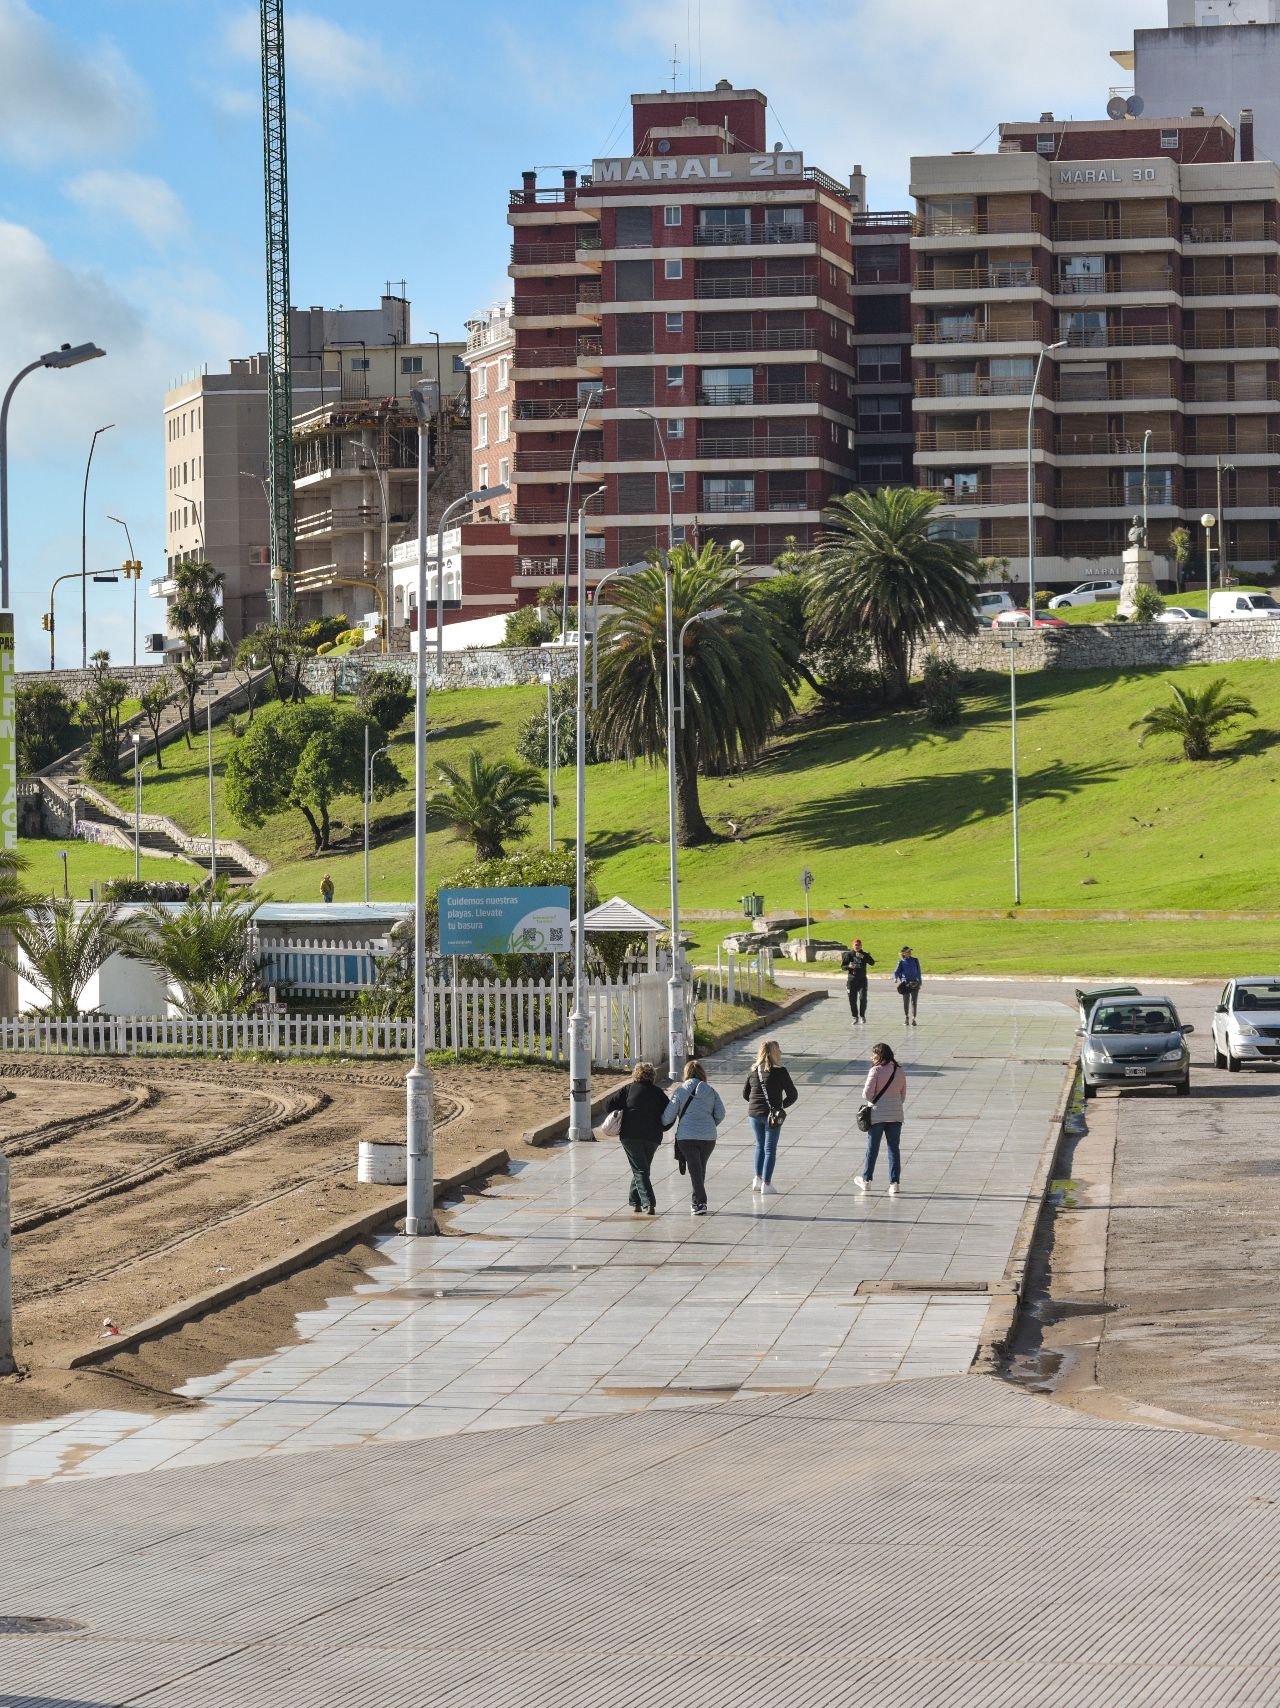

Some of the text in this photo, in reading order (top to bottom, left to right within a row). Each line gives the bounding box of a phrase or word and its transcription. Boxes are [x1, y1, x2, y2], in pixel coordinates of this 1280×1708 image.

[594, 154, 801, 182] MARAL 20
[1060, 168, 1155, 184] MARAL 30
[447, 896, 519, 906] Cuidemos nuestras
[447, 909, 474, 919] playas.
[448, 921, 484, 930] tu basura
